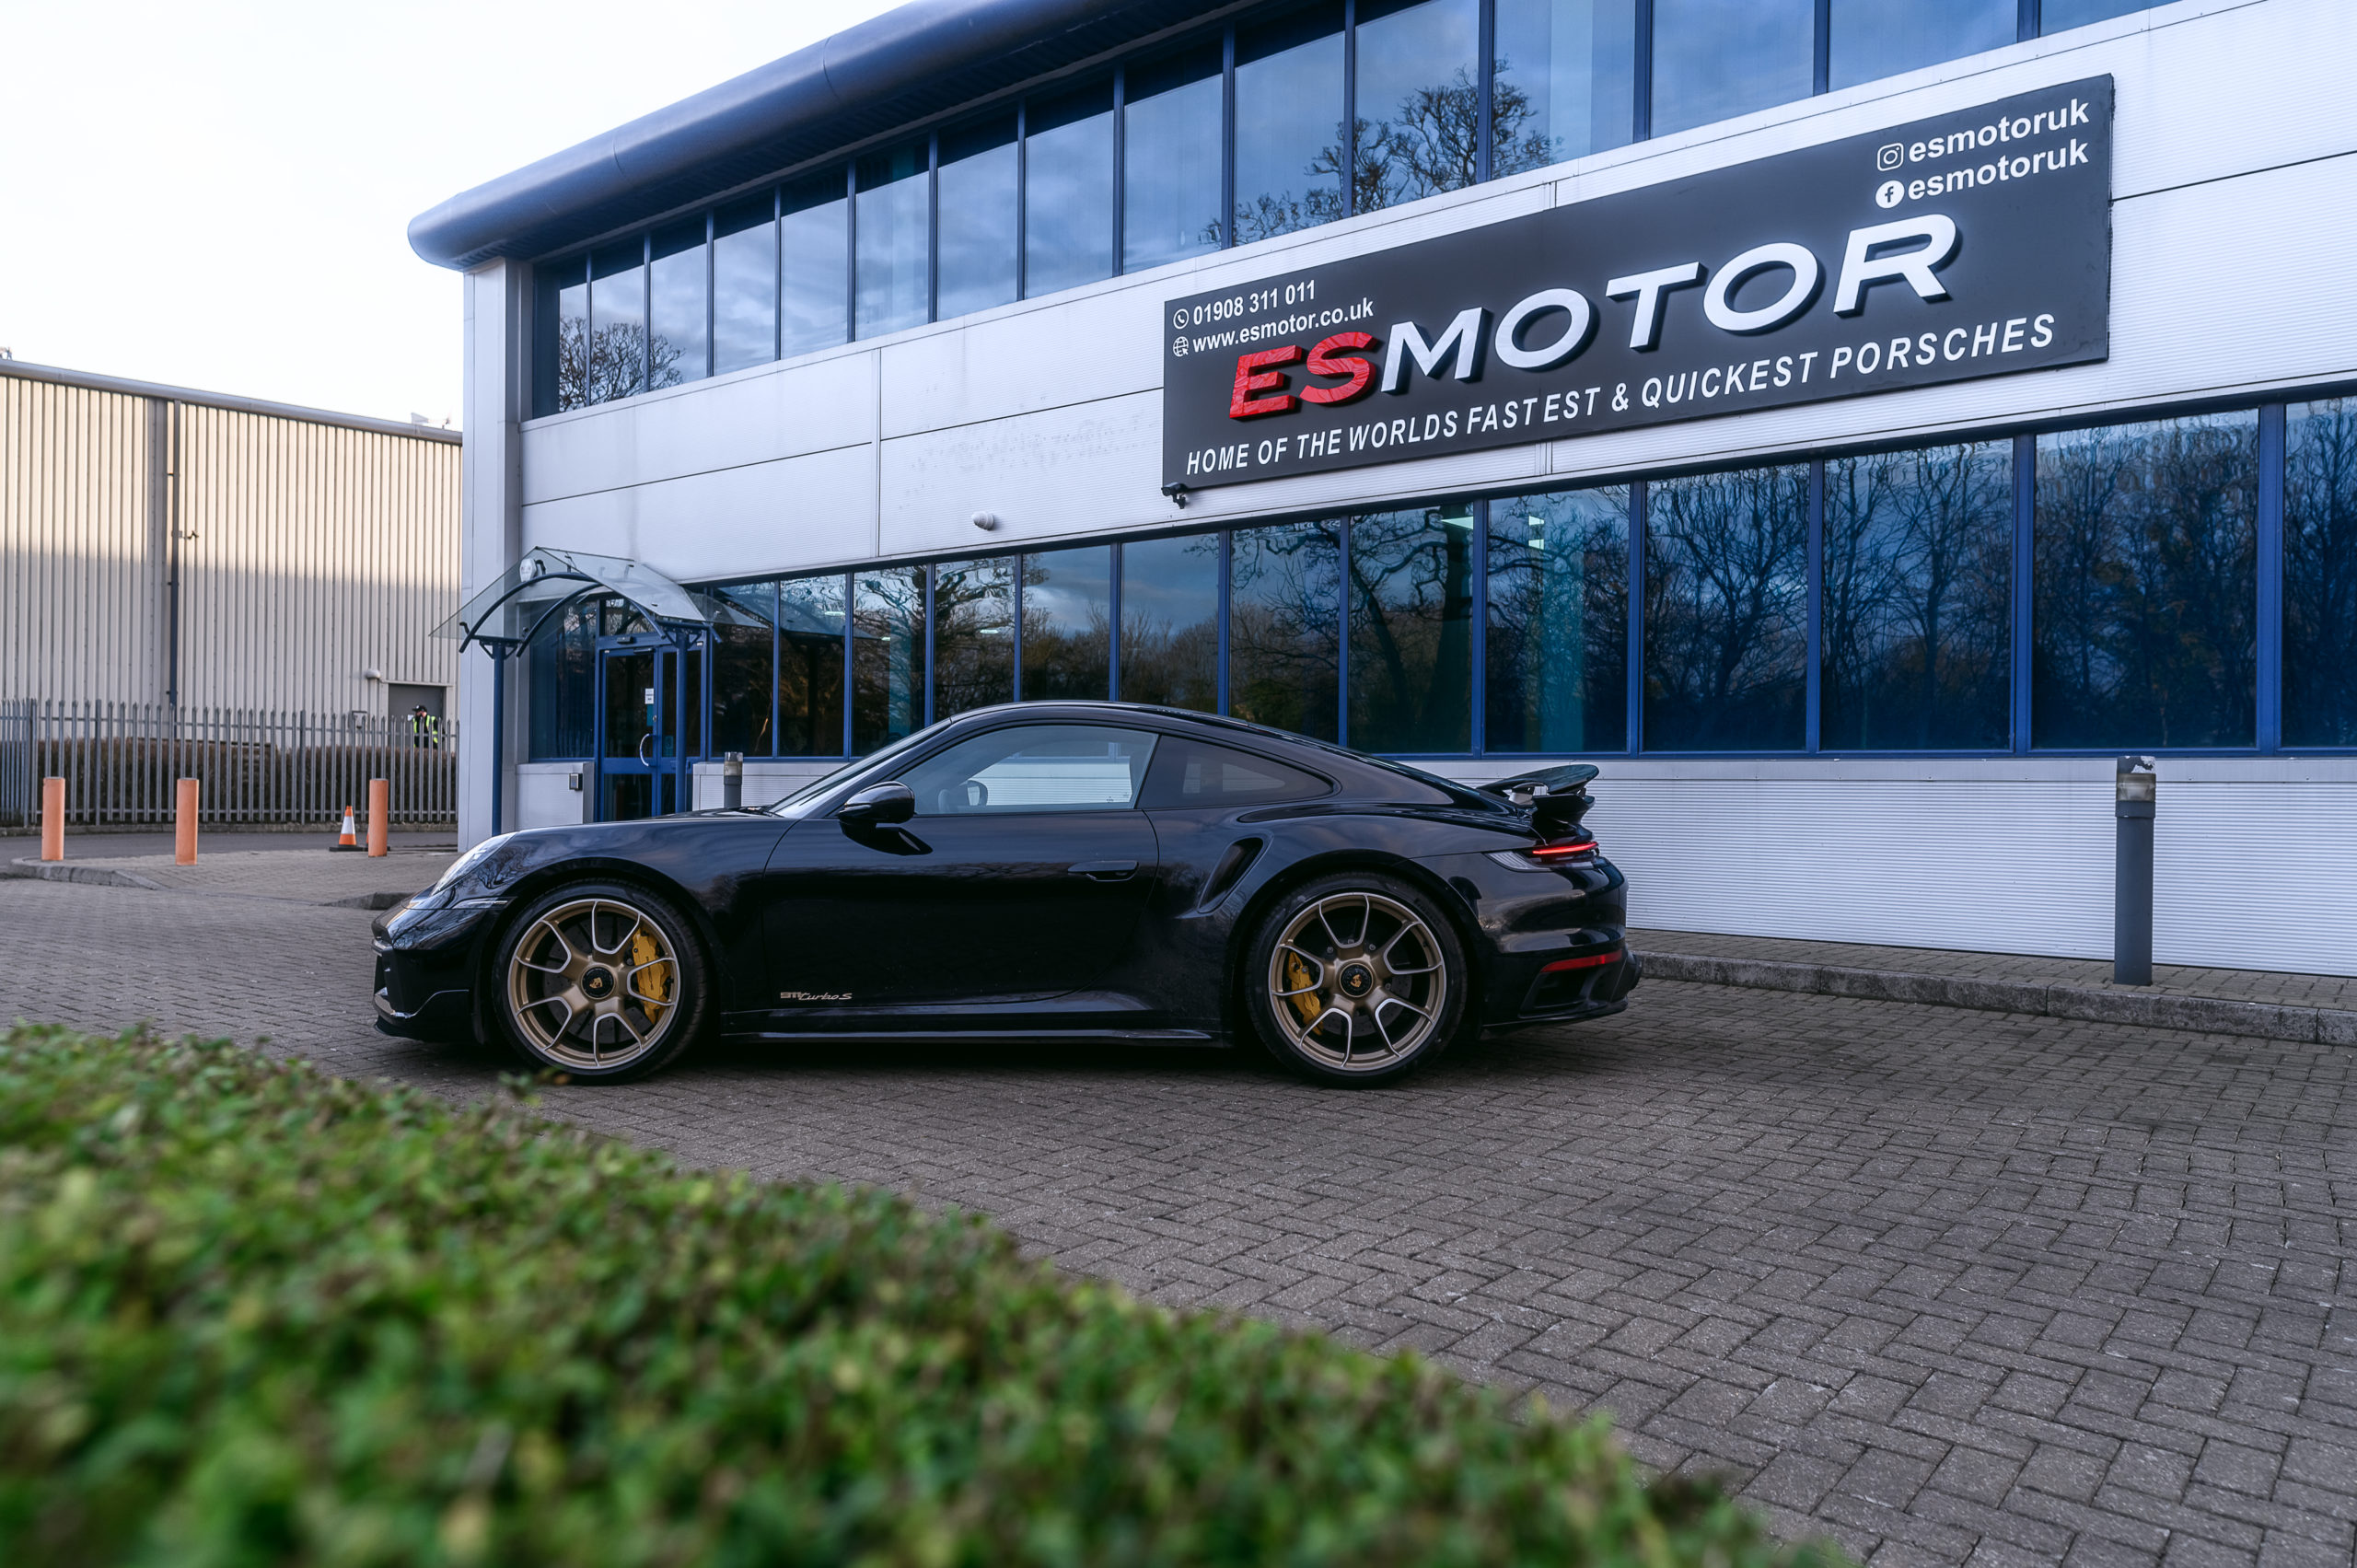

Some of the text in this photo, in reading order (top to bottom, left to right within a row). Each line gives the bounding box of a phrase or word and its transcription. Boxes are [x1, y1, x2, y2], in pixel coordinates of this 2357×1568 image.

[1909, 98, 2090, 163] esmotoruk
[1908, 138, 2090, 201] esmotoruk
[1192, 279, 1316, 325] 01908 311 011
[1192, 297, 1375, 354] www.esmotor.co.uk
[1229, 214, 1957, 421] ESMOTOR
[1186, 313, 2056, 476] HOME OF THE WORLDS FASTEST & QUICKEST PORSCHES
